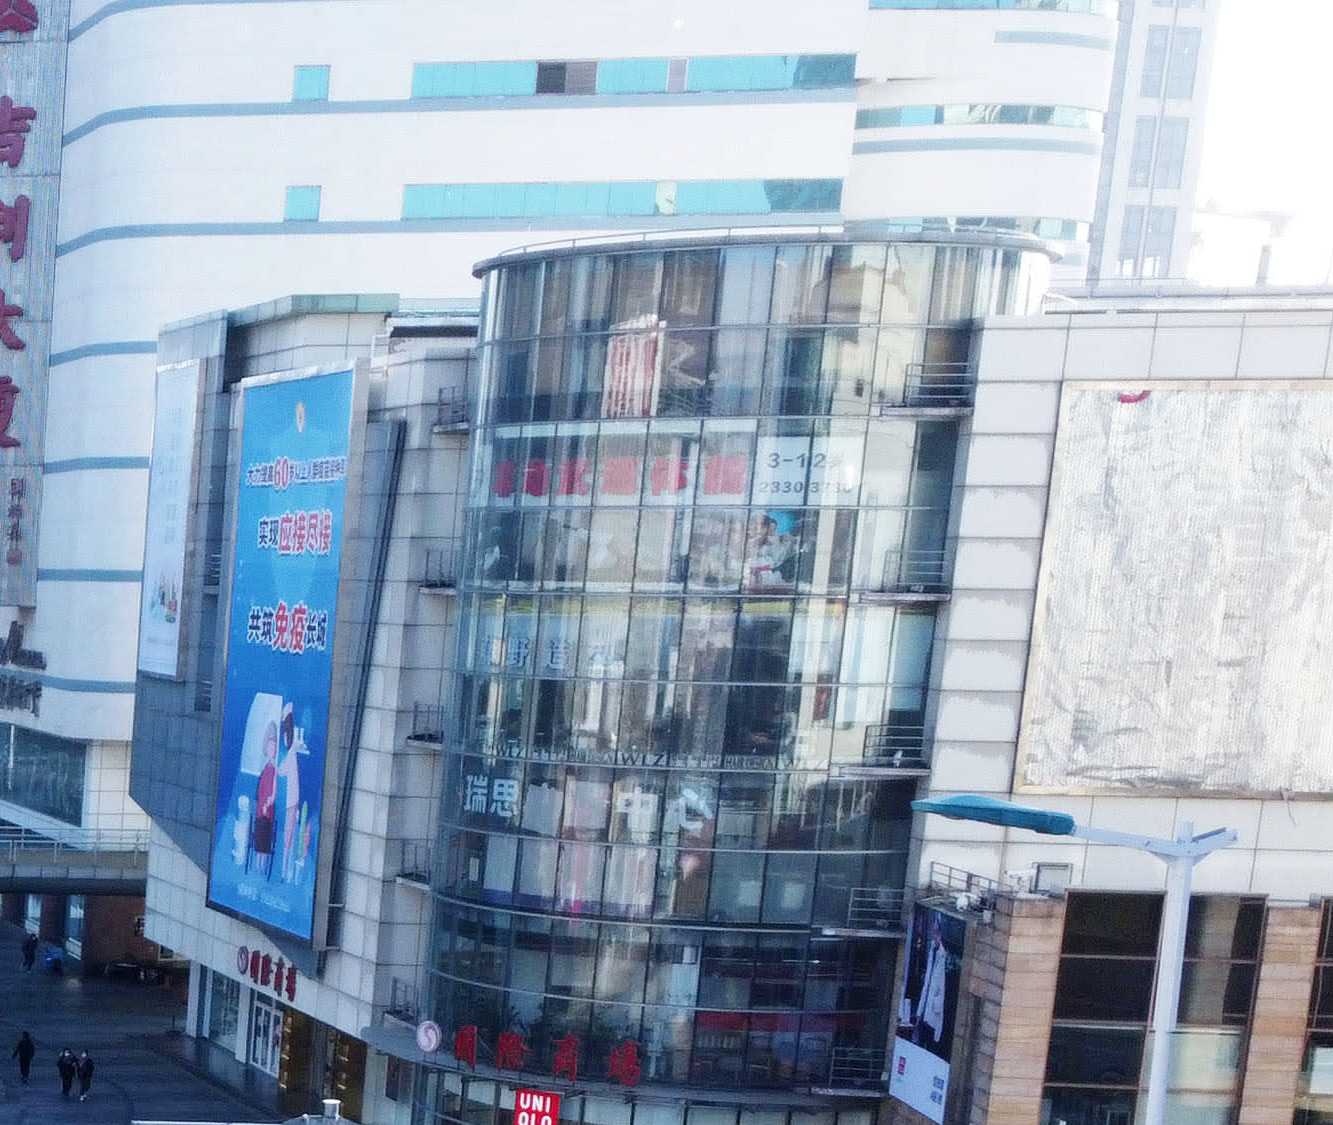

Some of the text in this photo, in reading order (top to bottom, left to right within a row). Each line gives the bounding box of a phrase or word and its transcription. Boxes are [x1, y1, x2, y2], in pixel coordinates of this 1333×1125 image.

[258, 509, 332, 555] 实现应接尽接
[247, 601, 327, 654] 共筑免疫长城
[519, 1092, 552, 1113] UNI
